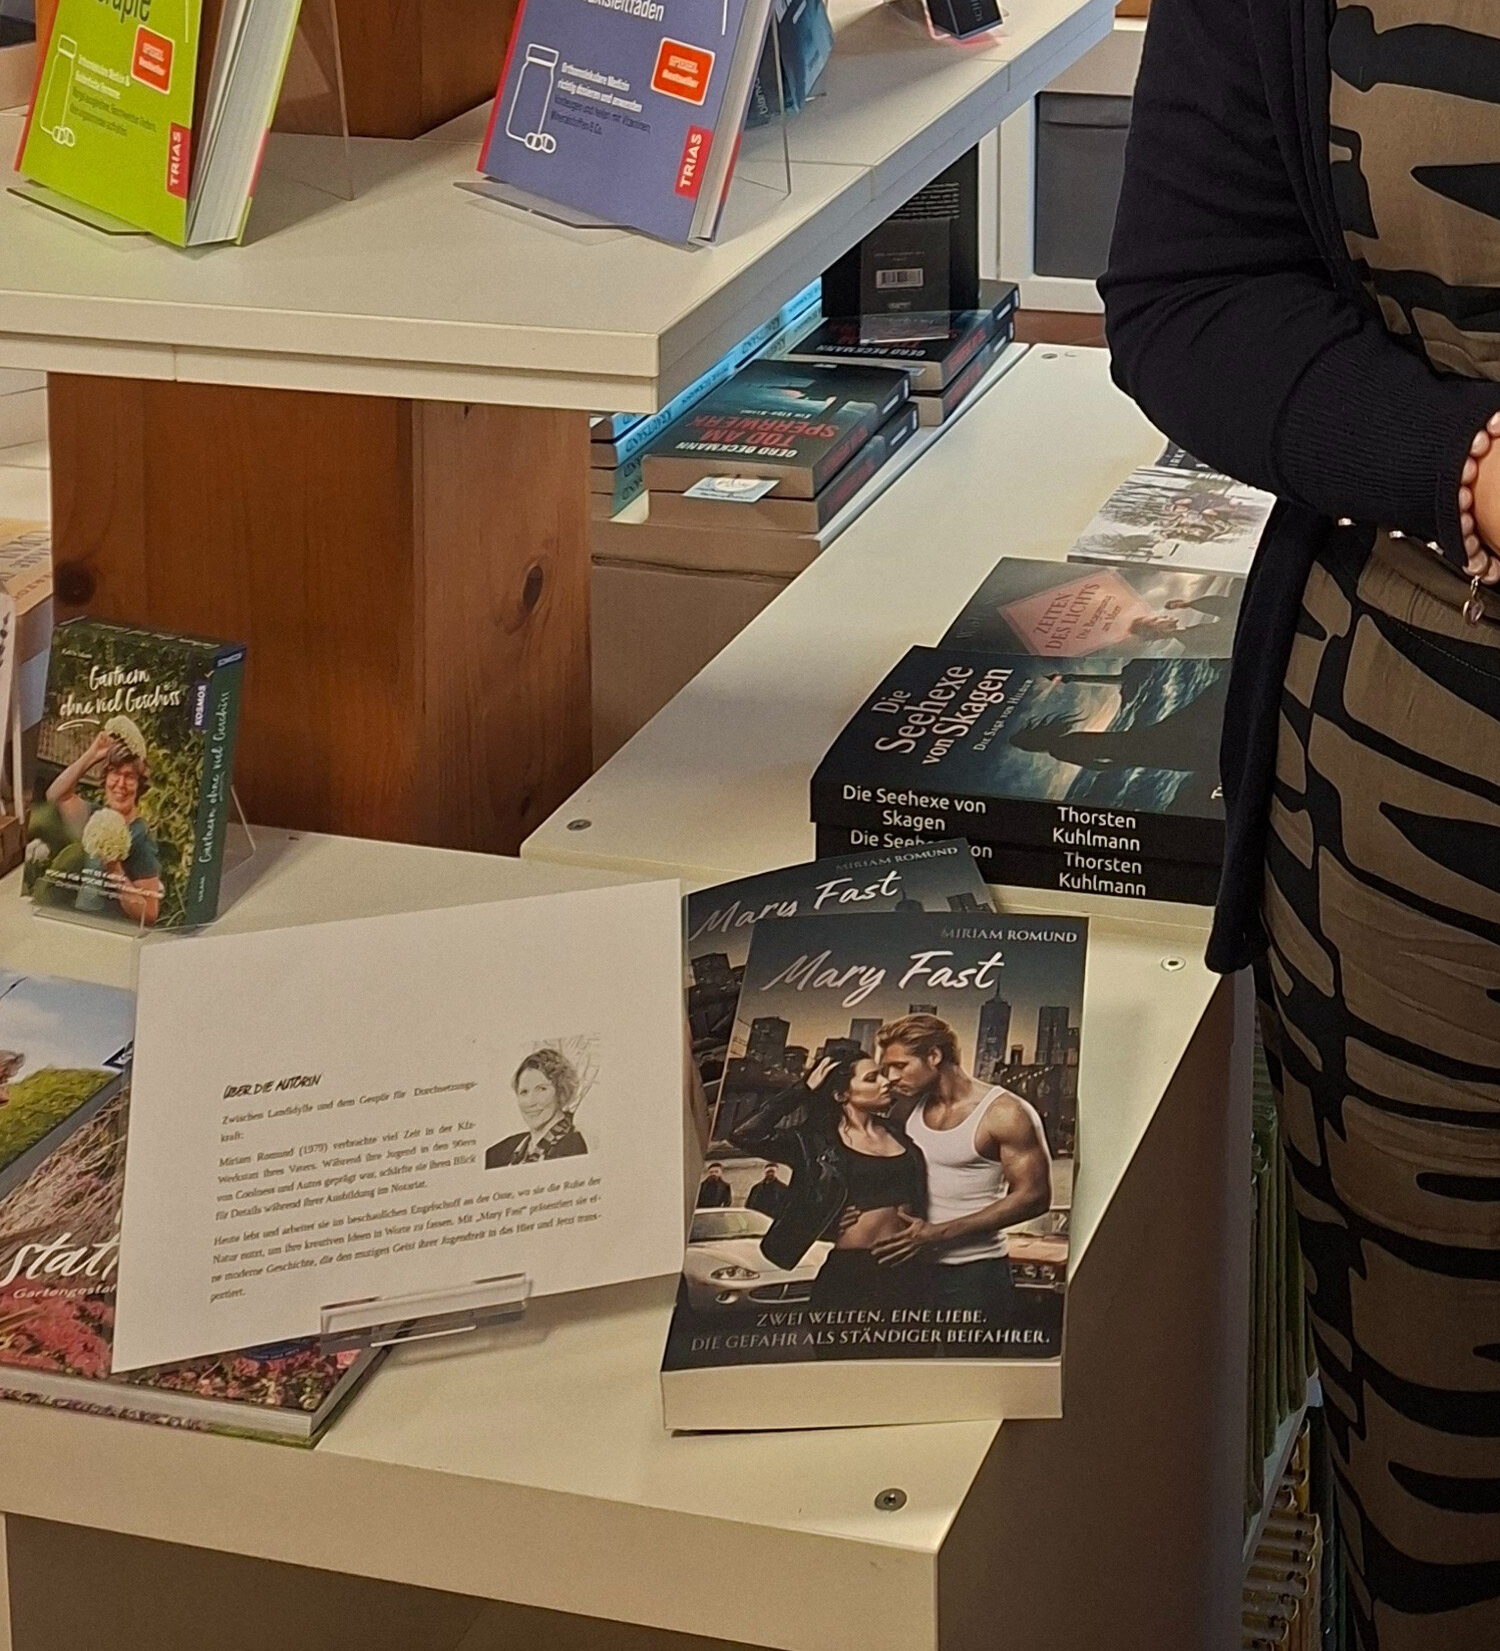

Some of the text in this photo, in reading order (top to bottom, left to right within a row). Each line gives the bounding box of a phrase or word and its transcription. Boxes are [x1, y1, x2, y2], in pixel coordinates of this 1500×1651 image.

[168, 130, 183, 187] TRIAS
[679, 133, 702, 188] TRIAS
[815, 344, 926, 358] GERD BECKMANN
[689, 413, 840, 439] SPERRWERK
[701, 428, 797, 448] TOD AM
[674, 440, 799, 460] GERD BECKMANN
[1032, 591, 1073, 636] ZEITEN
[1044, 582, 1101, 650] DES LICHTS
[1075, 621, 1091, 640] Die
[89, 665, 150, 690] Gärtnern
[60, 684, 181, 717] ohne viel Geschiss
[194, 684, 208, 727] KOSMOS
[871, 689, 911, 715] Die
[874, 665, 975, 754] Seehexe
[214, 691, 230, 742] Geschiss
[921, 667, 1015, 766] von Skagen
[212, 746, 224, 773] viel
[209, 776, 220, 807] ohne
[842, 783, 987, 815] Die Seehexe von
[882, 809, 946, 833] Skagen
[1056, 805, 1137, 831] Thorsten
[850, 829, 880, 847] Die
[1052, 826, 1142, 852] Kuhlmann
[835, 845, 959, 874] MIRIAM ROMUND
[1063, 852, 1143, 876] Thorsten
[812, 870, 902, 910] Fast
[1057, 871, 1147, 897] Kuhlmann
[940, 926, 1078, 944] MIRIAM ROMUND
[759, 948, 1005, 1009] Mary Fast
[223, 1073, 322, 1099] ÜBER DIE AUTORIN
[222, 1098, 355, 1125] Zwischen und dem
[219, 1131, 399, 1167] Miriam Romund verbrachte viel
[288, 1147, 417, 1174] Vaters. Während Jugend
[235, 1155, 477, 1199] Coolness und Autos Blick
[230, 1179, 429, 1219] Details während Ausbildung Notariat.
[243, 1206, 408, 1242] lebt und beschaulichen
[212, 1224, 412, 1265] Natur kreativen Ideen Worte
[225, 1251, 352, 1281] moderne Geschichte, die den
[756, 1308, 987, 1328] ZWEI WELTEN. EINE LIEBE.
[690, 1327, 1051, 1352] DIE GEFAHR ALS STÄNDIGER BEIFAHRER.
